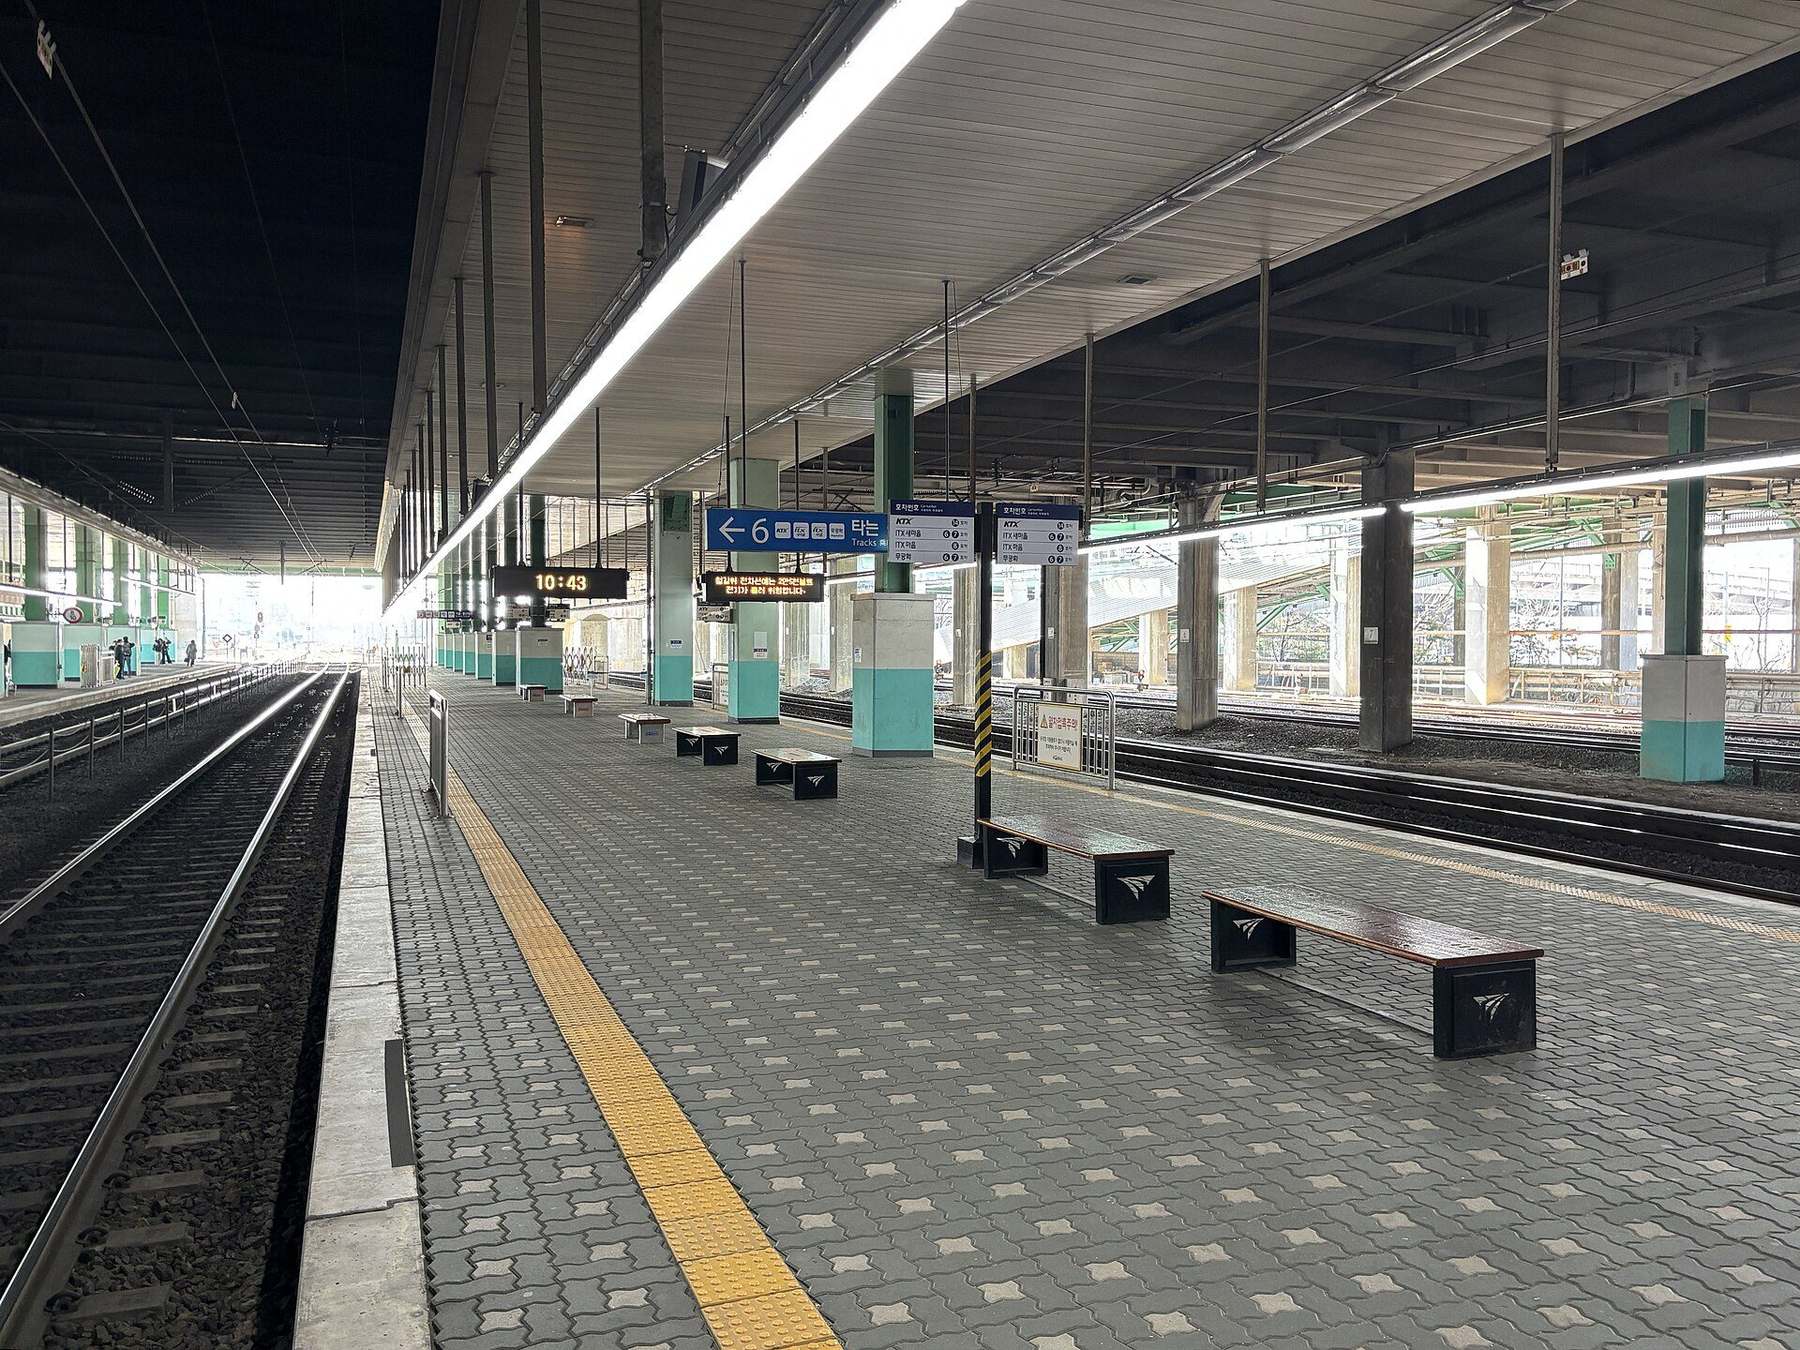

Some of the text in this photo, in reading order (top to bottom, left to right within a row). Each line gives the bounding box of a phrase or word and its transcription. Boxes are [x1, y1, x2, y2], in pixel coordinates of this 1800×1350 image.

[895, 503, 919, 512] 호차번호
[1003, 507, 1026, 516] 호차번호
[851, 519, 879, 537] 타는
[1003, 520, 1020, 528] KTX
[752, 518, 770, 544] 6
[851, 538, 877, 547] Tracks
[535, 574, 588, 590] 10:43
